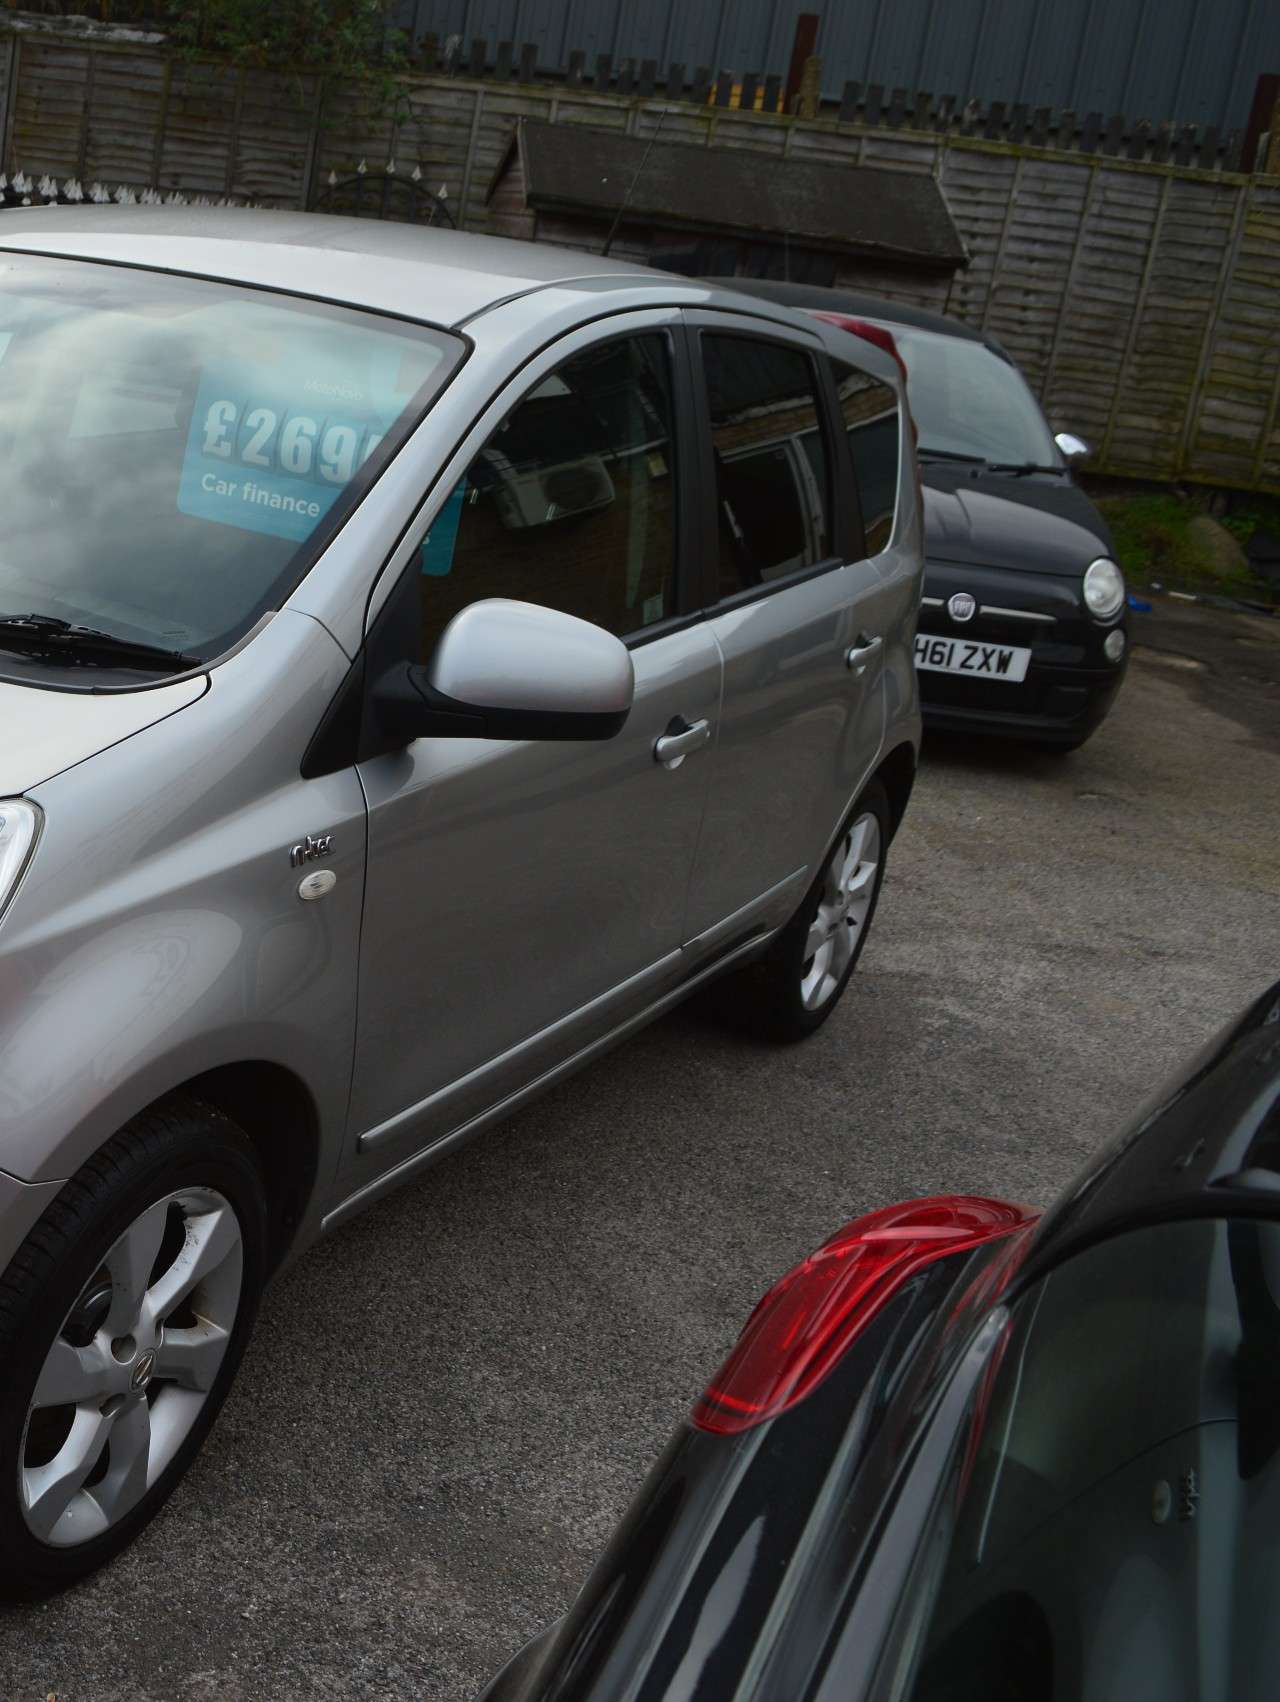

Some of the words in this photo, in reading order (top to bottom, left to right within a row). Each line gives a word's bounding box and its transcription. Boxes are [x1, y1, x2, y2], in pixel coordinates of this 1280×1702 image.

[203, 399, 383, 484] £269
[201, 472, 236, 498] Car
[242, 483, 321, 517] finance
[915, 638, 956, 667] H61
[960, 644, 1014, 674] ZXW
